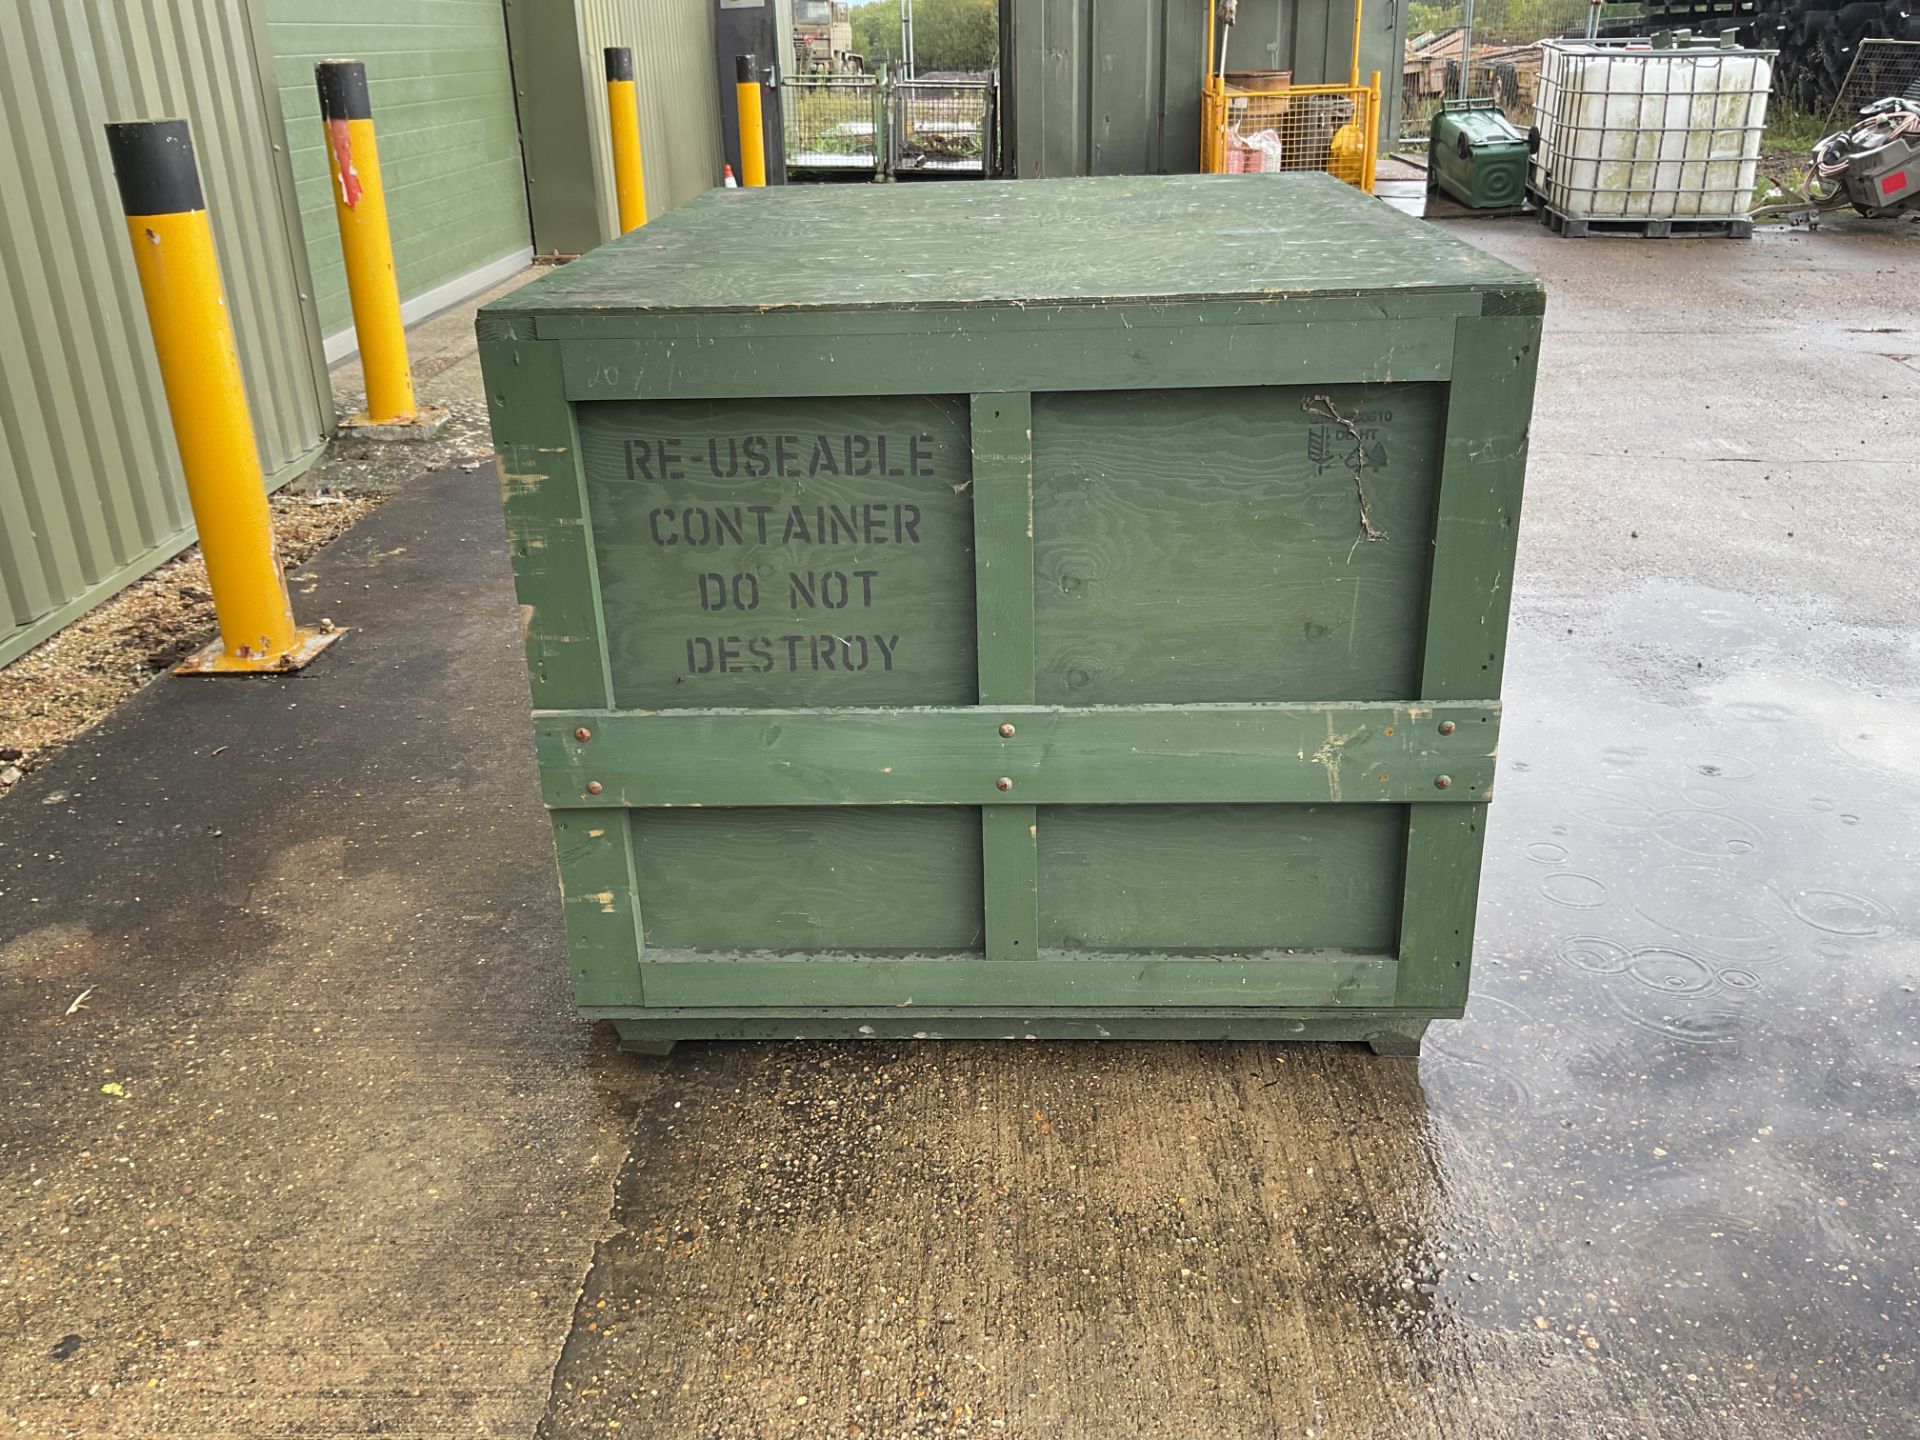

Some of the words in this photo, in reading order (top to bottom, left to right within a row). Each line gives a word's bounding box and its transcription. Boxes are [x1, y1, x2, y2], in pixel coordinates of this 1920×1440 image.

[623, 434, 936, 481] RE-USEABLE
[648, 504, 922, 547] CONTAINER
[698, 572, 760, 612] DO
[789, 570, 880, 611] NOT
[686, 634, 901, 674] DESTROY
